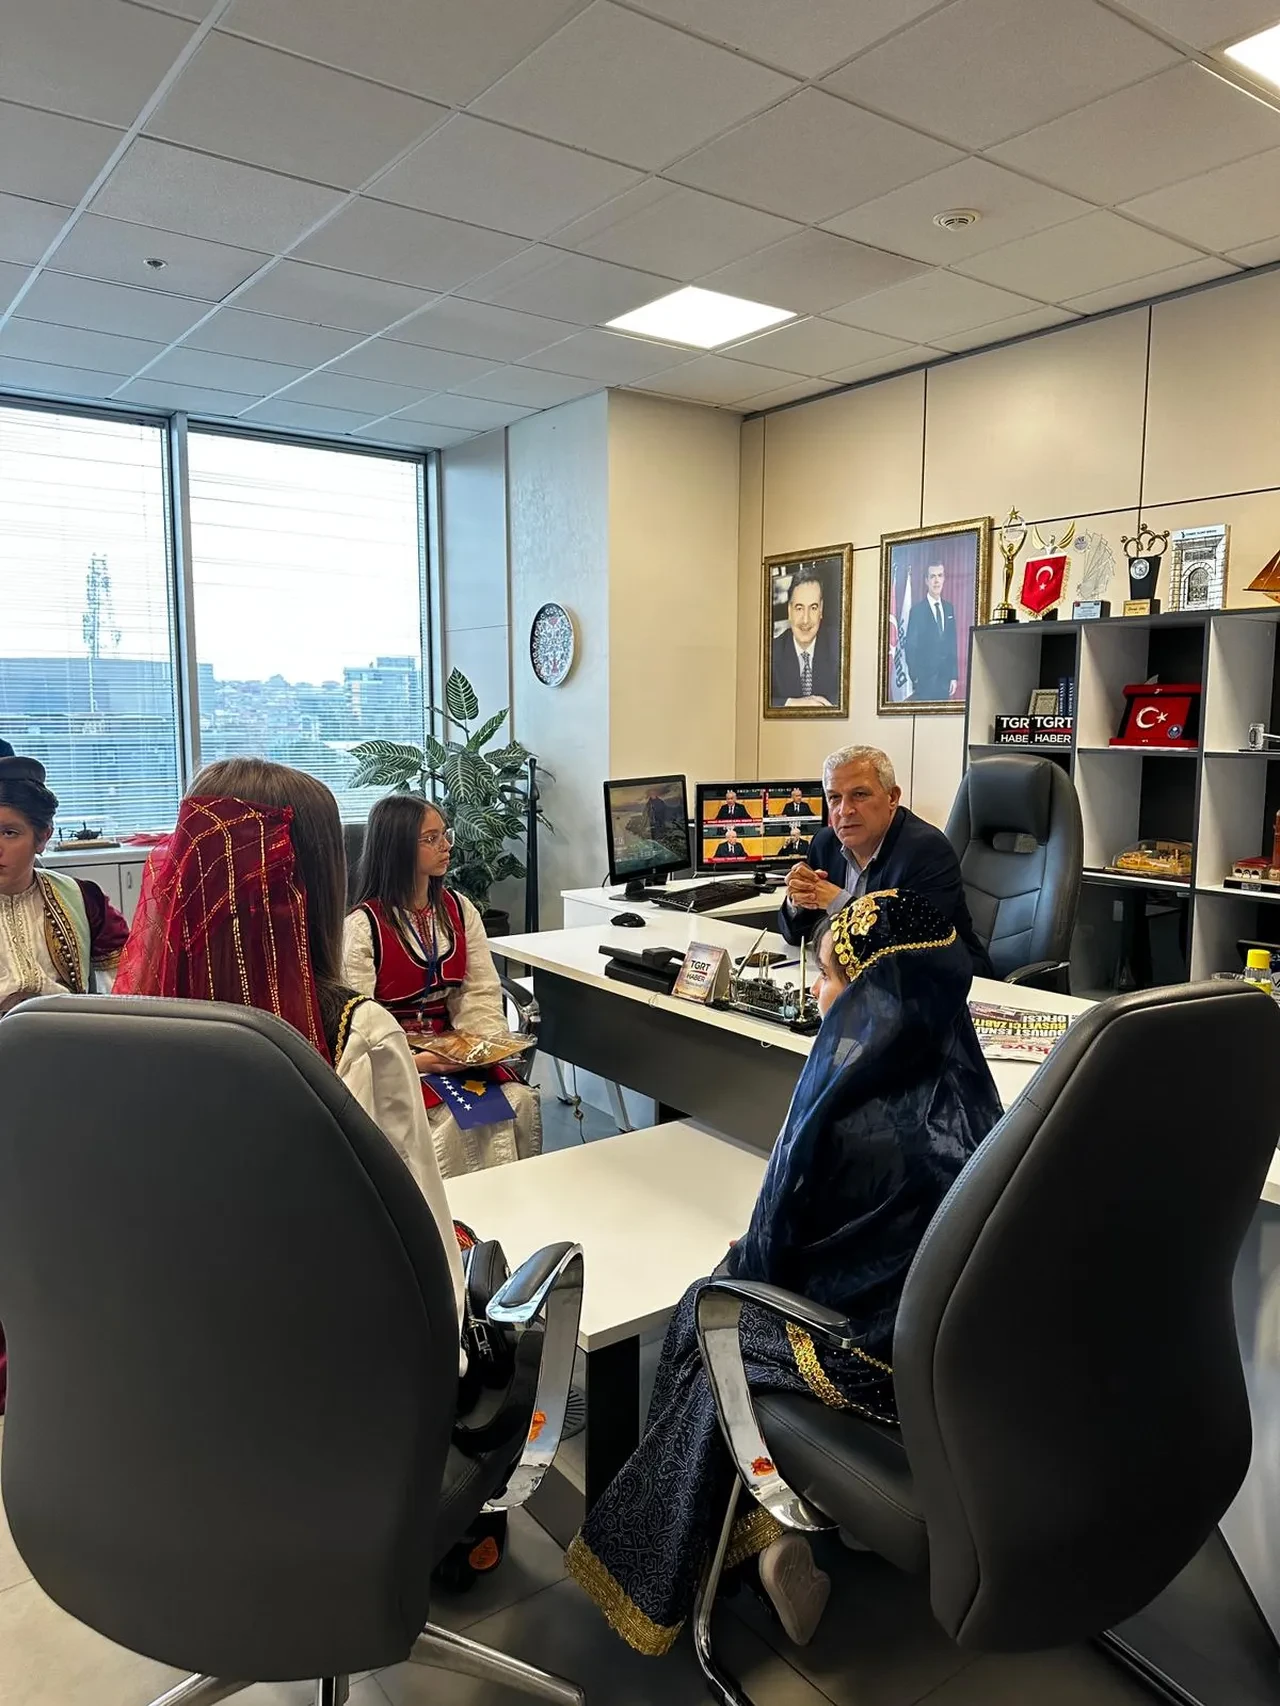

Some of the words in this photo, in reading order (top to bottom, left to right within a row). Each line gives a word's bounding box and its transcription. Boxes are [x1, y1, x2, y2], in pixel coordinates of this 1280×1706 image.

[1000, 717, 1030, 728] TGR
[1034, 716, 1073, 728] TGRT
[1000, 734, 1029, 743] HABE
[1034, 733, 1072, 744] HABER
[690, 960, 711, 971] TGRT
